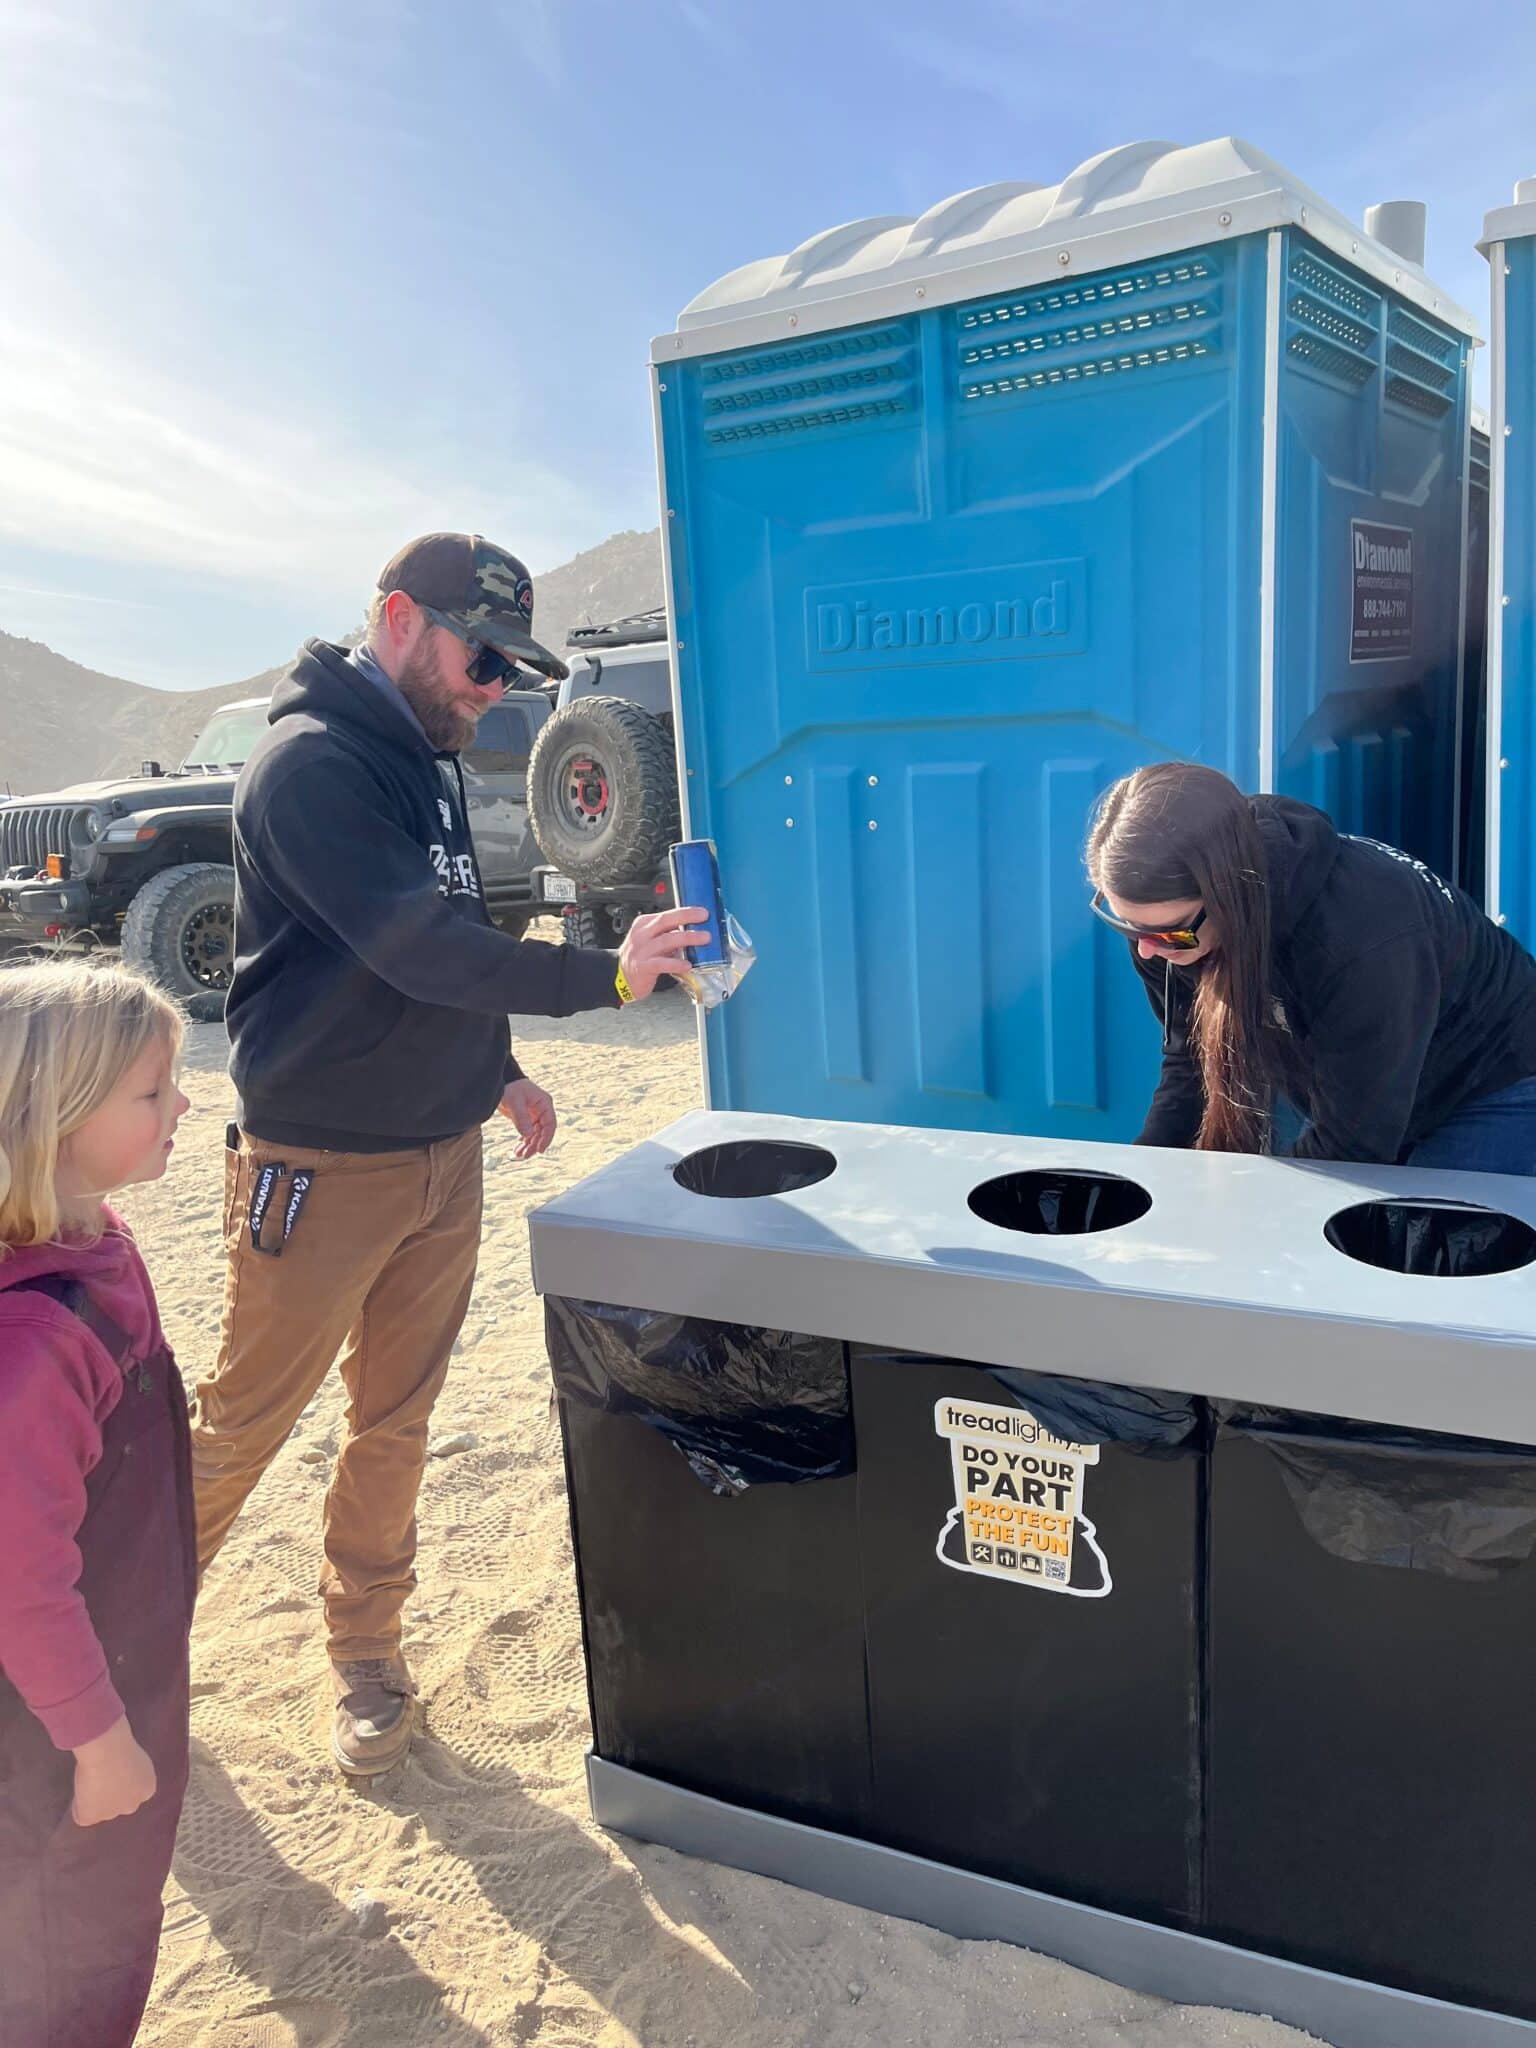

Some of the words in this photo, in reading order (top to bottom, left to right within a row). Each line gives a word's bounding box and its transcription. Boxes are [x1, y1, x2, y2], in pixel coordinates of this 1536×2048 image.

[1355, 531, 1412, 573] Diamond
[817, 580, 1069, 654] Diamond
[254, 1168, 274, 1216] KANATI
[947, 1406, 1082, 1450] treadligh
[963, 1445, 998, 1466] DO
[1004, 1452, 1075, 1482] YOUR
[967, 1466, 1072, 1511] PART
[967, 1498, 1072, 1534] PROTECT
[970, 1520, 1015, 1544] THE
[1019, 1529, 1069, 1557] FUN
